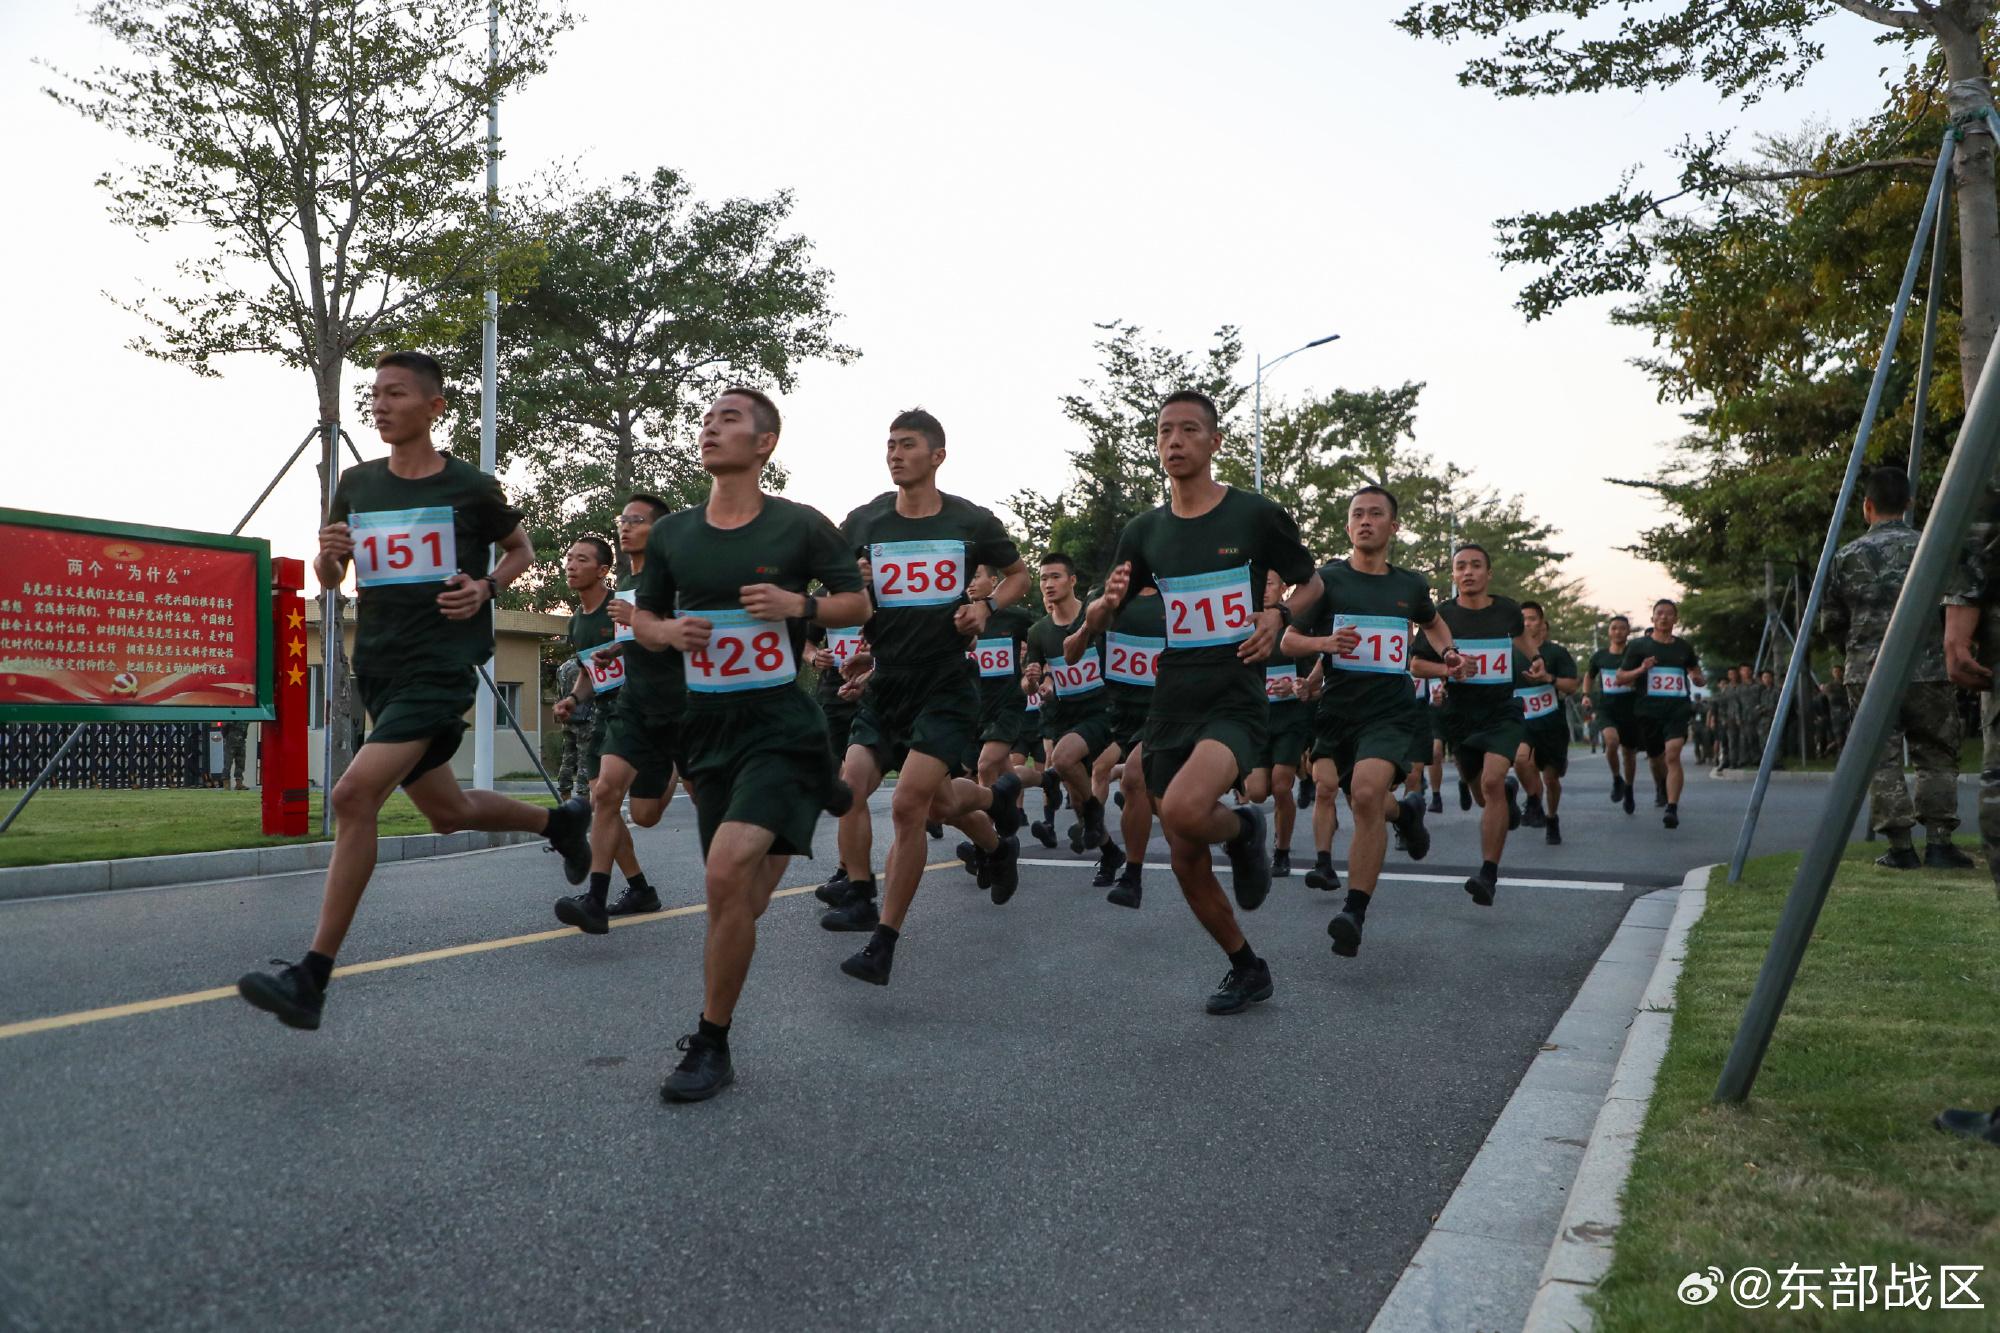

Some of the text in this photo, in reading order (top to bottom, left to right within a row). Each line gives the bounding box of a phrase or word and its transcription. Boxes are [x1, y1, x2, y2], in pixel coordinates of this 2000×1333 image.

[362, 531, 442, 572] 151
[67, 559, 191, 584] 两个“为什么”
[880, 559, 957, 595] 258
[1170, 591, 1247, 635] 215
[689, 631, 784, 678] 428
[834, 639, 864, 660] 47
[1054, 661, 1101, 688] 002
[1459, 652, 1508, 676] 14
[1651, 675, 1684, 691] 329
